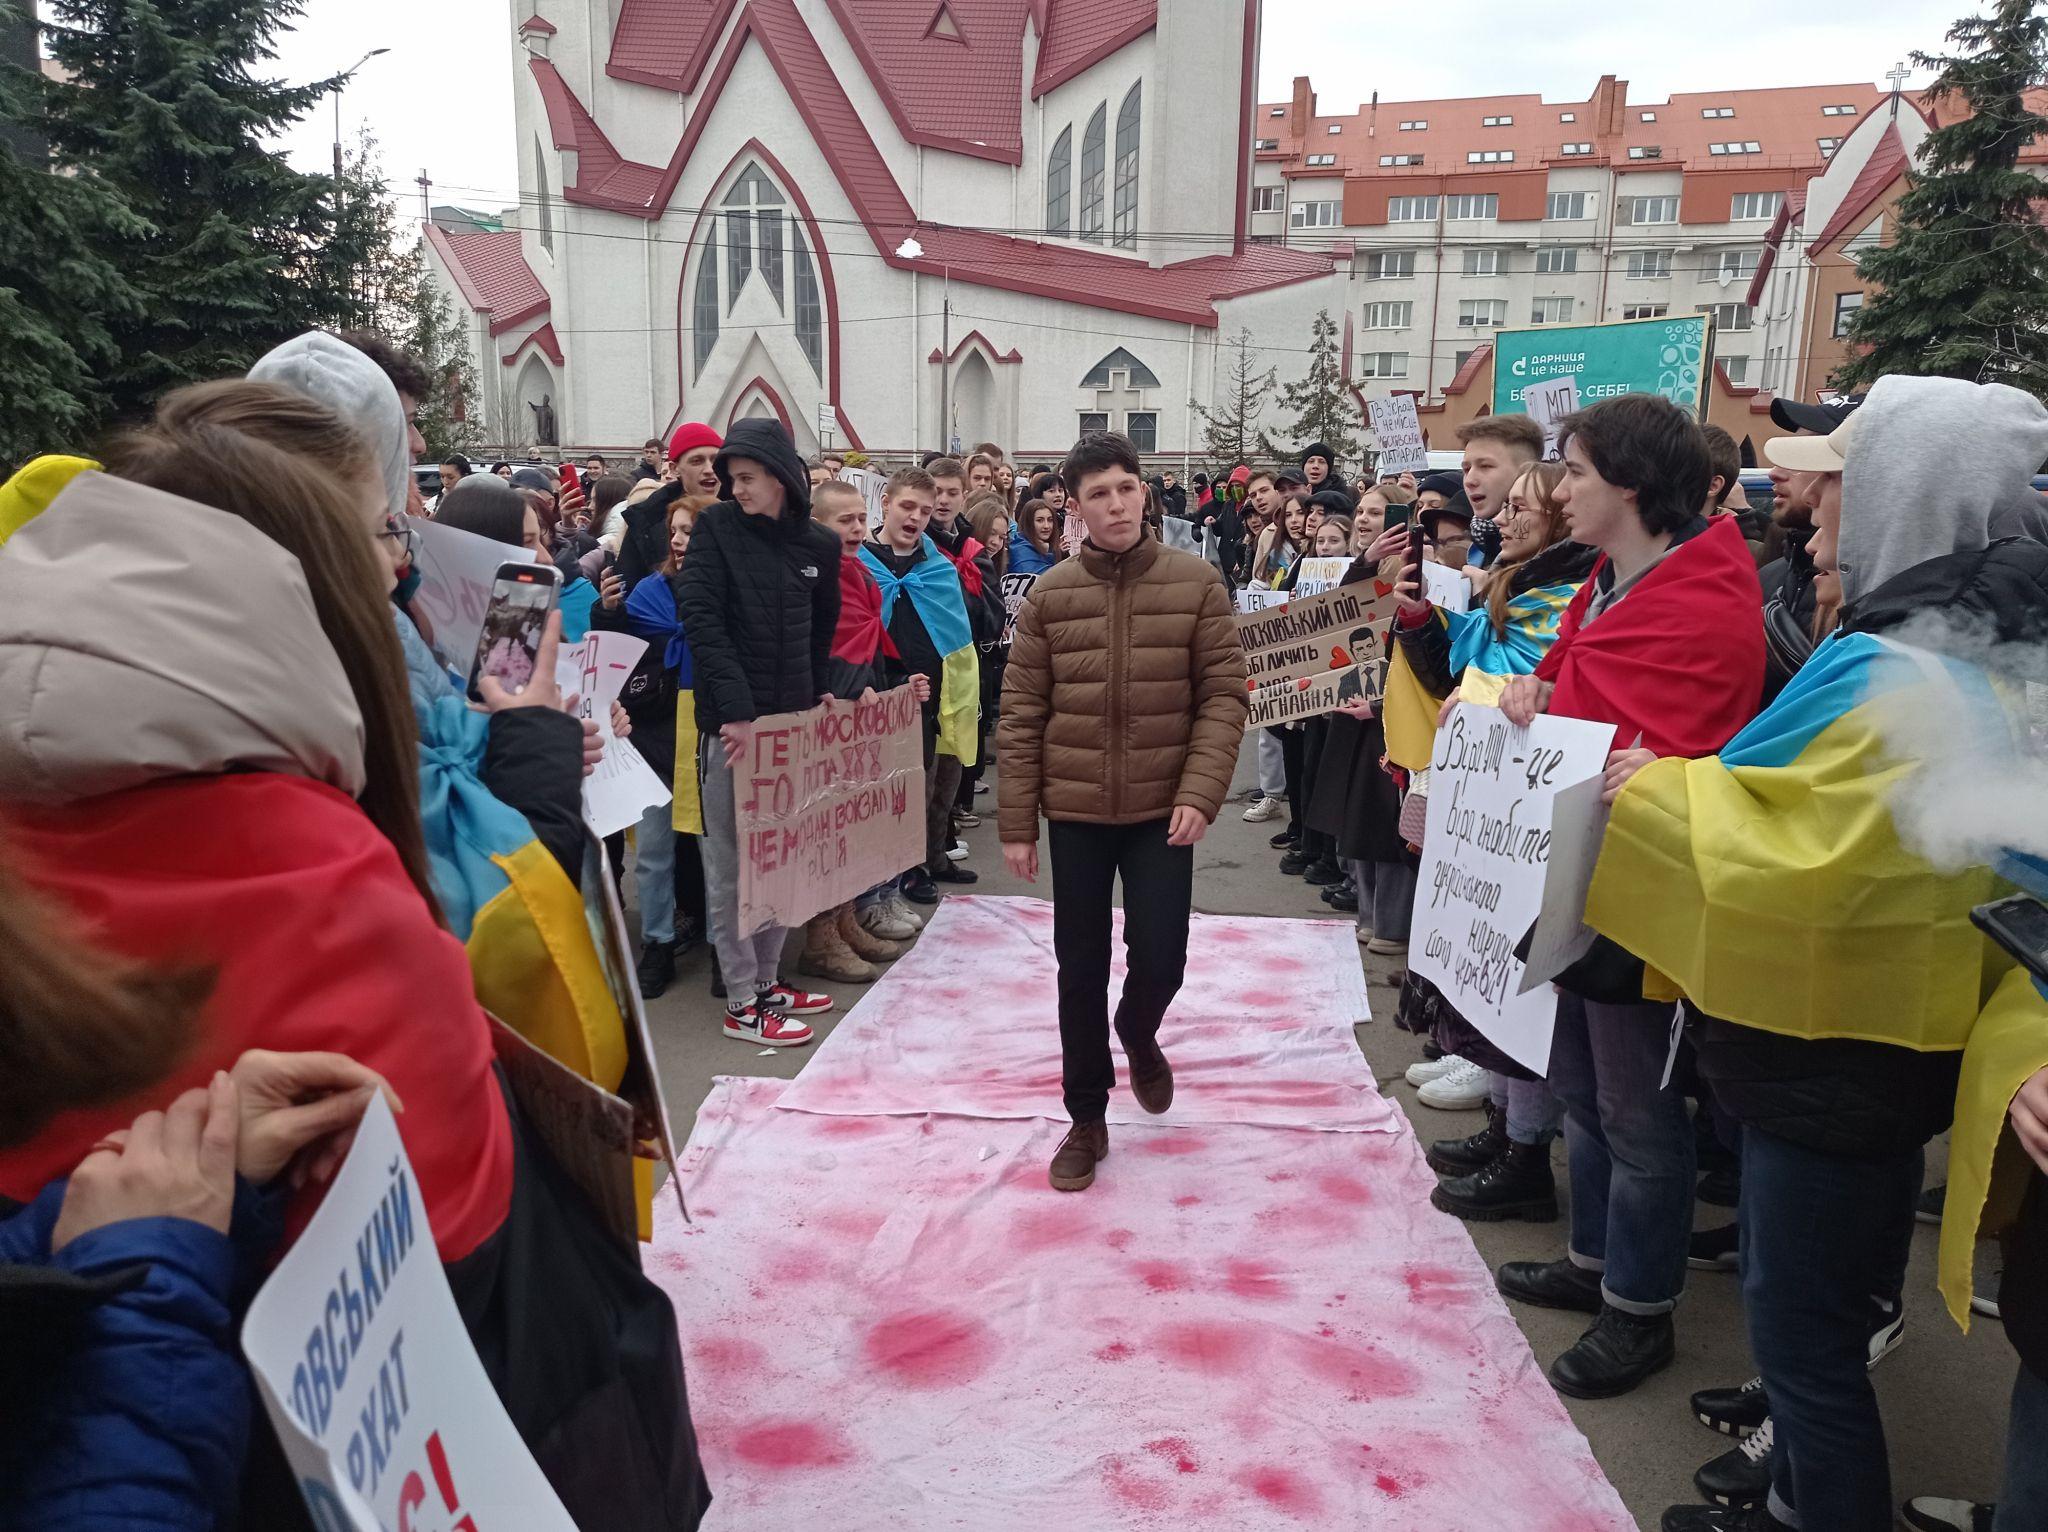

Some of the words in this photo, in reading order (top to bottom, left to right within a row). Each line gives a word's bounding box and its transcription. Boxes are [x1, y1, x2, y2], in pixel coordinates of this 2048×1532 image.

[1531, 365, 1547, 377] це
[1549, 363, 1585, 374] наше
[1246, 655, 1264, 678] ОБІ
[1267, 644, 1319, 673] ЛИЧИТЬ
[1250, 686, 1334, 725] ВИГНАННЯ
[755, 720, 811, 774] ГЕТЬ
[1436, 708, 1483, 797] Віра
[749, 810, 831, 874] ЧЕМОДАН
[835, 787, 888, 830] ВОКЗАЛ
[1446, 779, 1476, 858] віра
[289, 1154, 416, 1440] ОВСЬКИЙ
[346, 1325, 411, 1500] РХАТ
